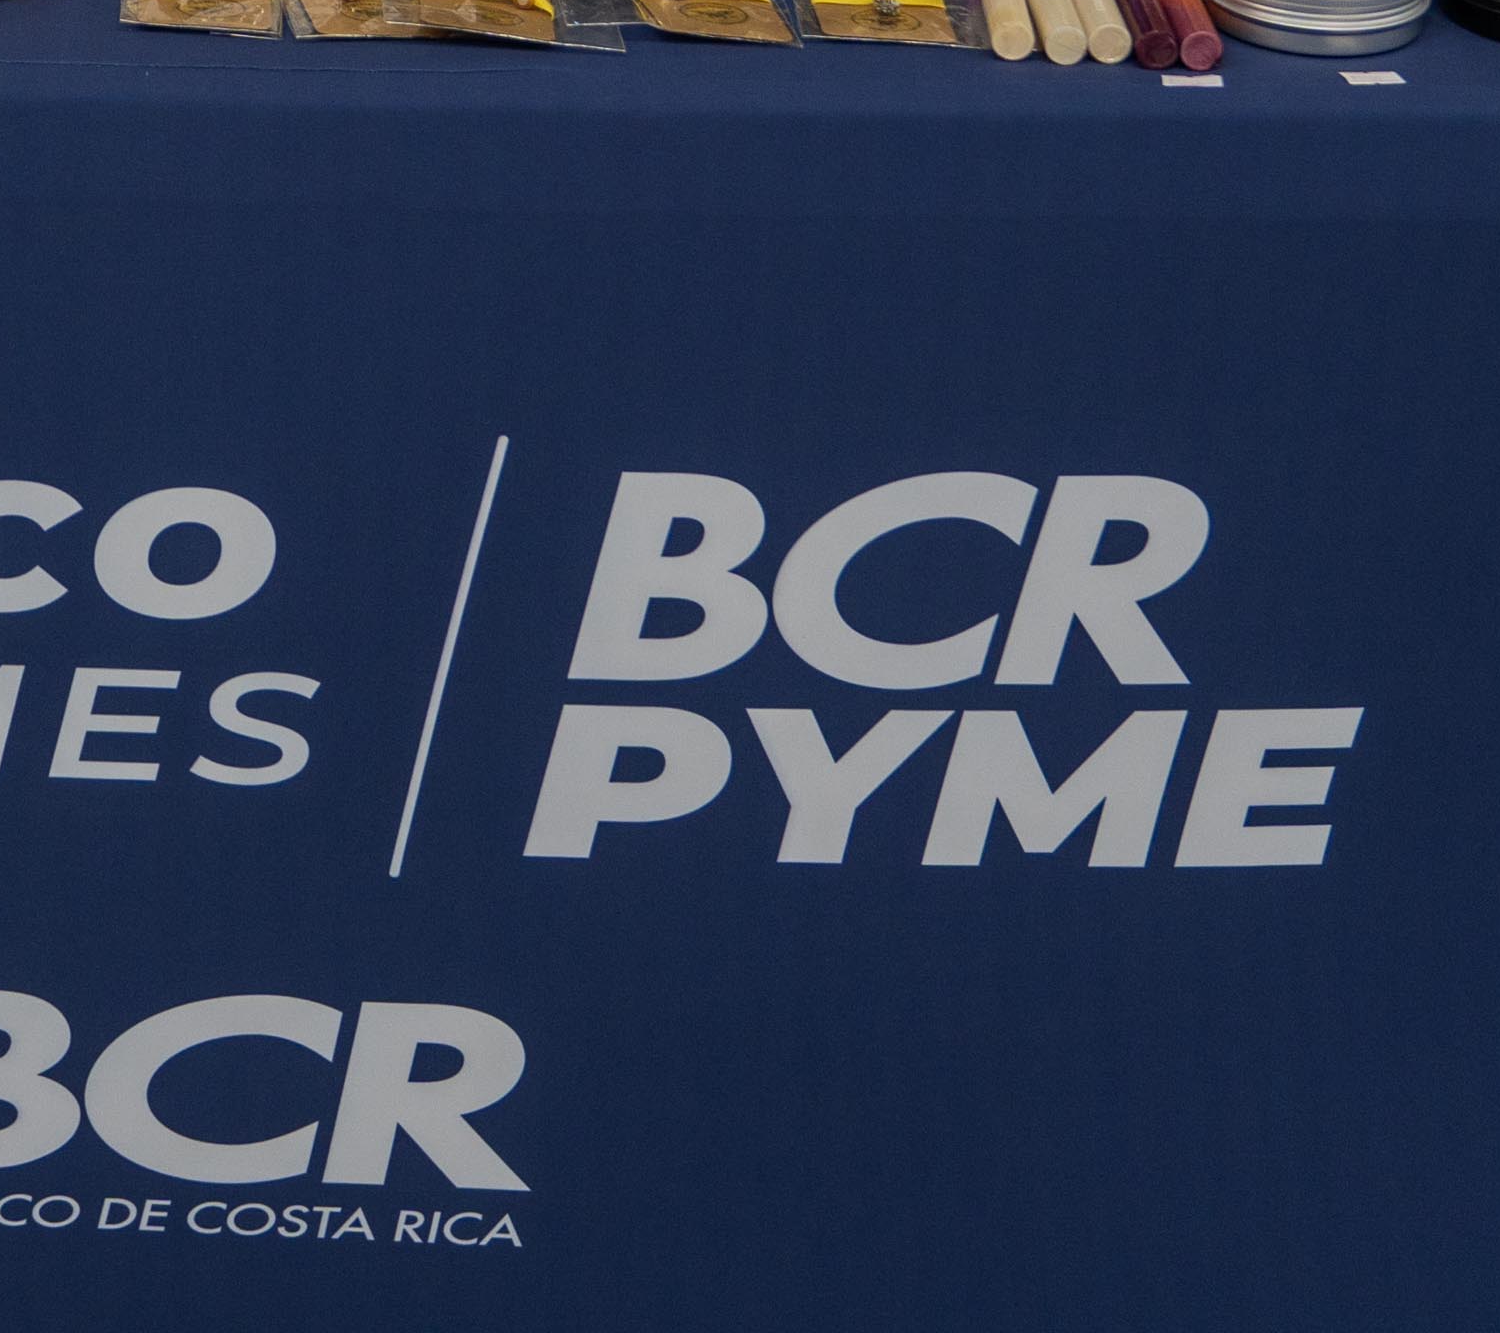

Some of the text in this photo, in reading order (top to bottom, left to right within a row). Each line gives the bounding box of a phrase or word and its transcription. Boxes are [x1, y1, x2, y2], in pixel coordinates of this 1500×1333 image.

[566, 470, 1211, 691] BCR
[521, 705, 1366, 868] PYME
[98, 1197, 171, 1233] DE
[184, 1199, 378, 1242] COSTA
[392, 1207, 524, 1248] RICA
